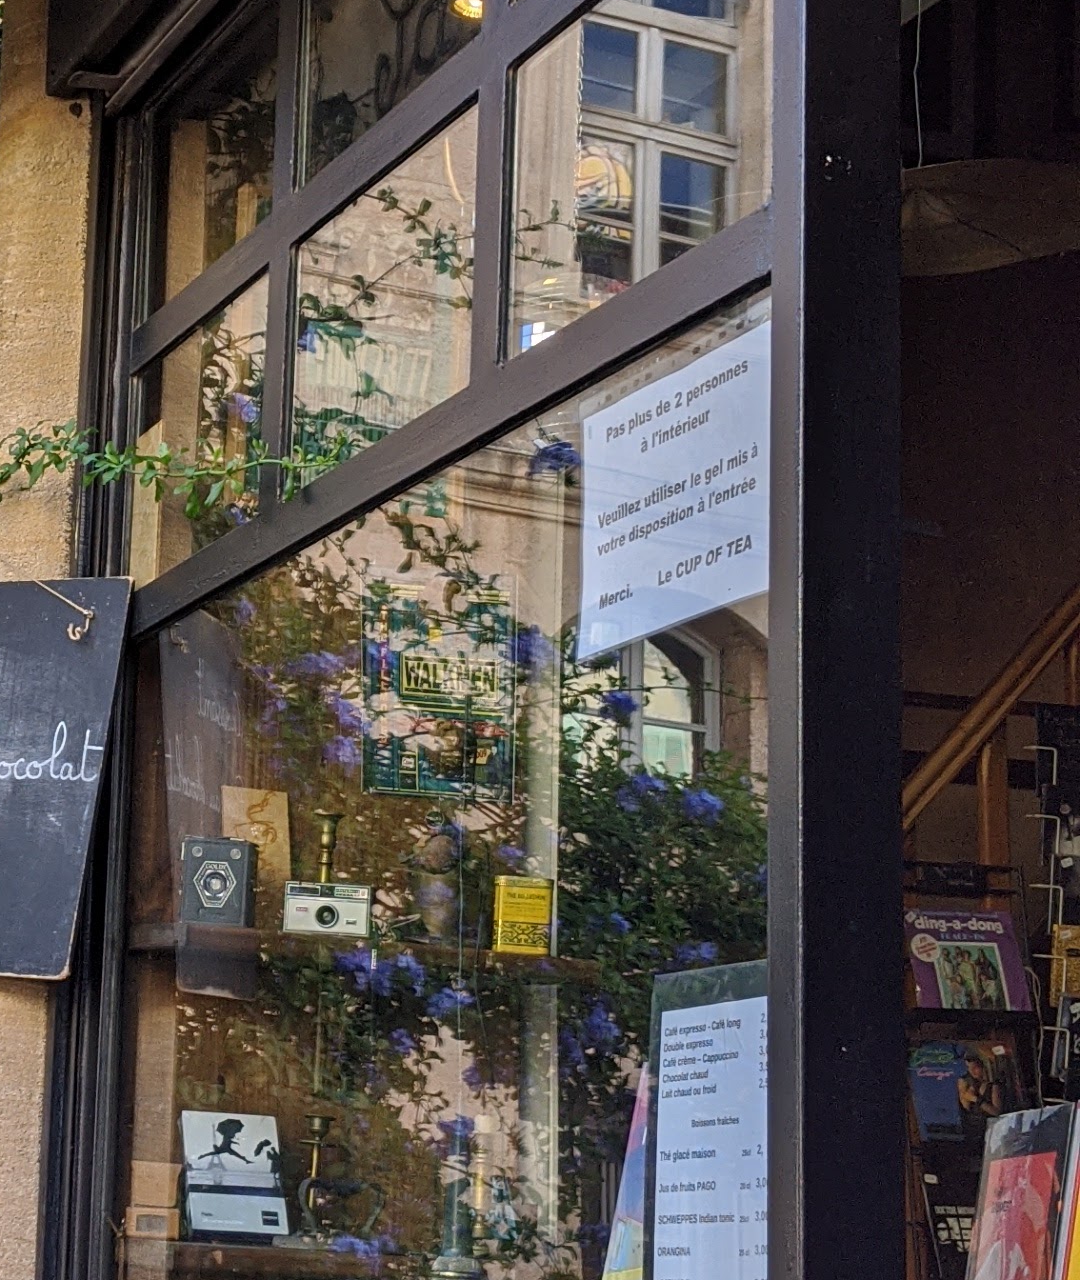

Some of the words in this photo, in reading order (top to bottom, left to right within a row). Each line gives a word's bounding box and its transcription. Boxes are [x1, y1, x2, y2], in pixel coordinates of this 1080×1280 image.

[606, 423, 625, 443] Pas
[628, 411, 652, 435] plus
[655, 399, 671, 417] de
[675, 392, 683, 408] 2
[686, 360, 749, 407] personnes
[640, 436, 648, 454] à
[651, 409, 711, 448] l'intérieur
[597, 499, 641, 529] Veuillez
[644, 477, 687, 509] utiliser
[690, 473, 701, 491] le
[704, 459, 724, 486] gel
[727, 450, 748, 472] mis
[751, 442, 758, 458] à
[597, 532, 626, 556] votre
[629, 506, 693, 543] disposition
[697, 496, 705, 513] à
[708, 477, 756, 508] l'entrée
[599, 584, 633, 610] Merci.
[658, 568, 672, 587] Le
[676, 555, 701, 579] CUP
[705, 547, 722, 567] OF
[726, 534, 753, 559] TEA
[914, 916, 1004, 934] ding-a-dong
[679, 1023, 706, 1036] expresso
[711, 1019, 725, 1031] Café
[726, 1018, 741, 1029] long
[664, 1041, 684, 1052] Double
[686, 1039, 713, 1051] expresso
[702, 1051, 739, 1064] Cappuccino
[662, 1071, 688, 1083] Chocolat
[690, 1069, 709, 1081] chaud
[662, 1089, 672, 1099] Lait
[674, 1086, 692, 1097] chaud
[693, 1087, 700, 1096] ou
[702, 1084, 717, 1094] froid
[660, 1150, 671, 1161] Thé
[673, 1149, 690, 1163] glacé
[691, 1149, 716, 1159] maison
[659, 1183, 669, 1193] Jus
[670, 1183, 679, 1192] de
[679, 1182, 696, 1192] fruits
[697, 1181, 716, 1191] PAGO
[658, 1214, 697, 1225] SCHWEPPES
[657, 1247, 691, 1256] ORANGINA
